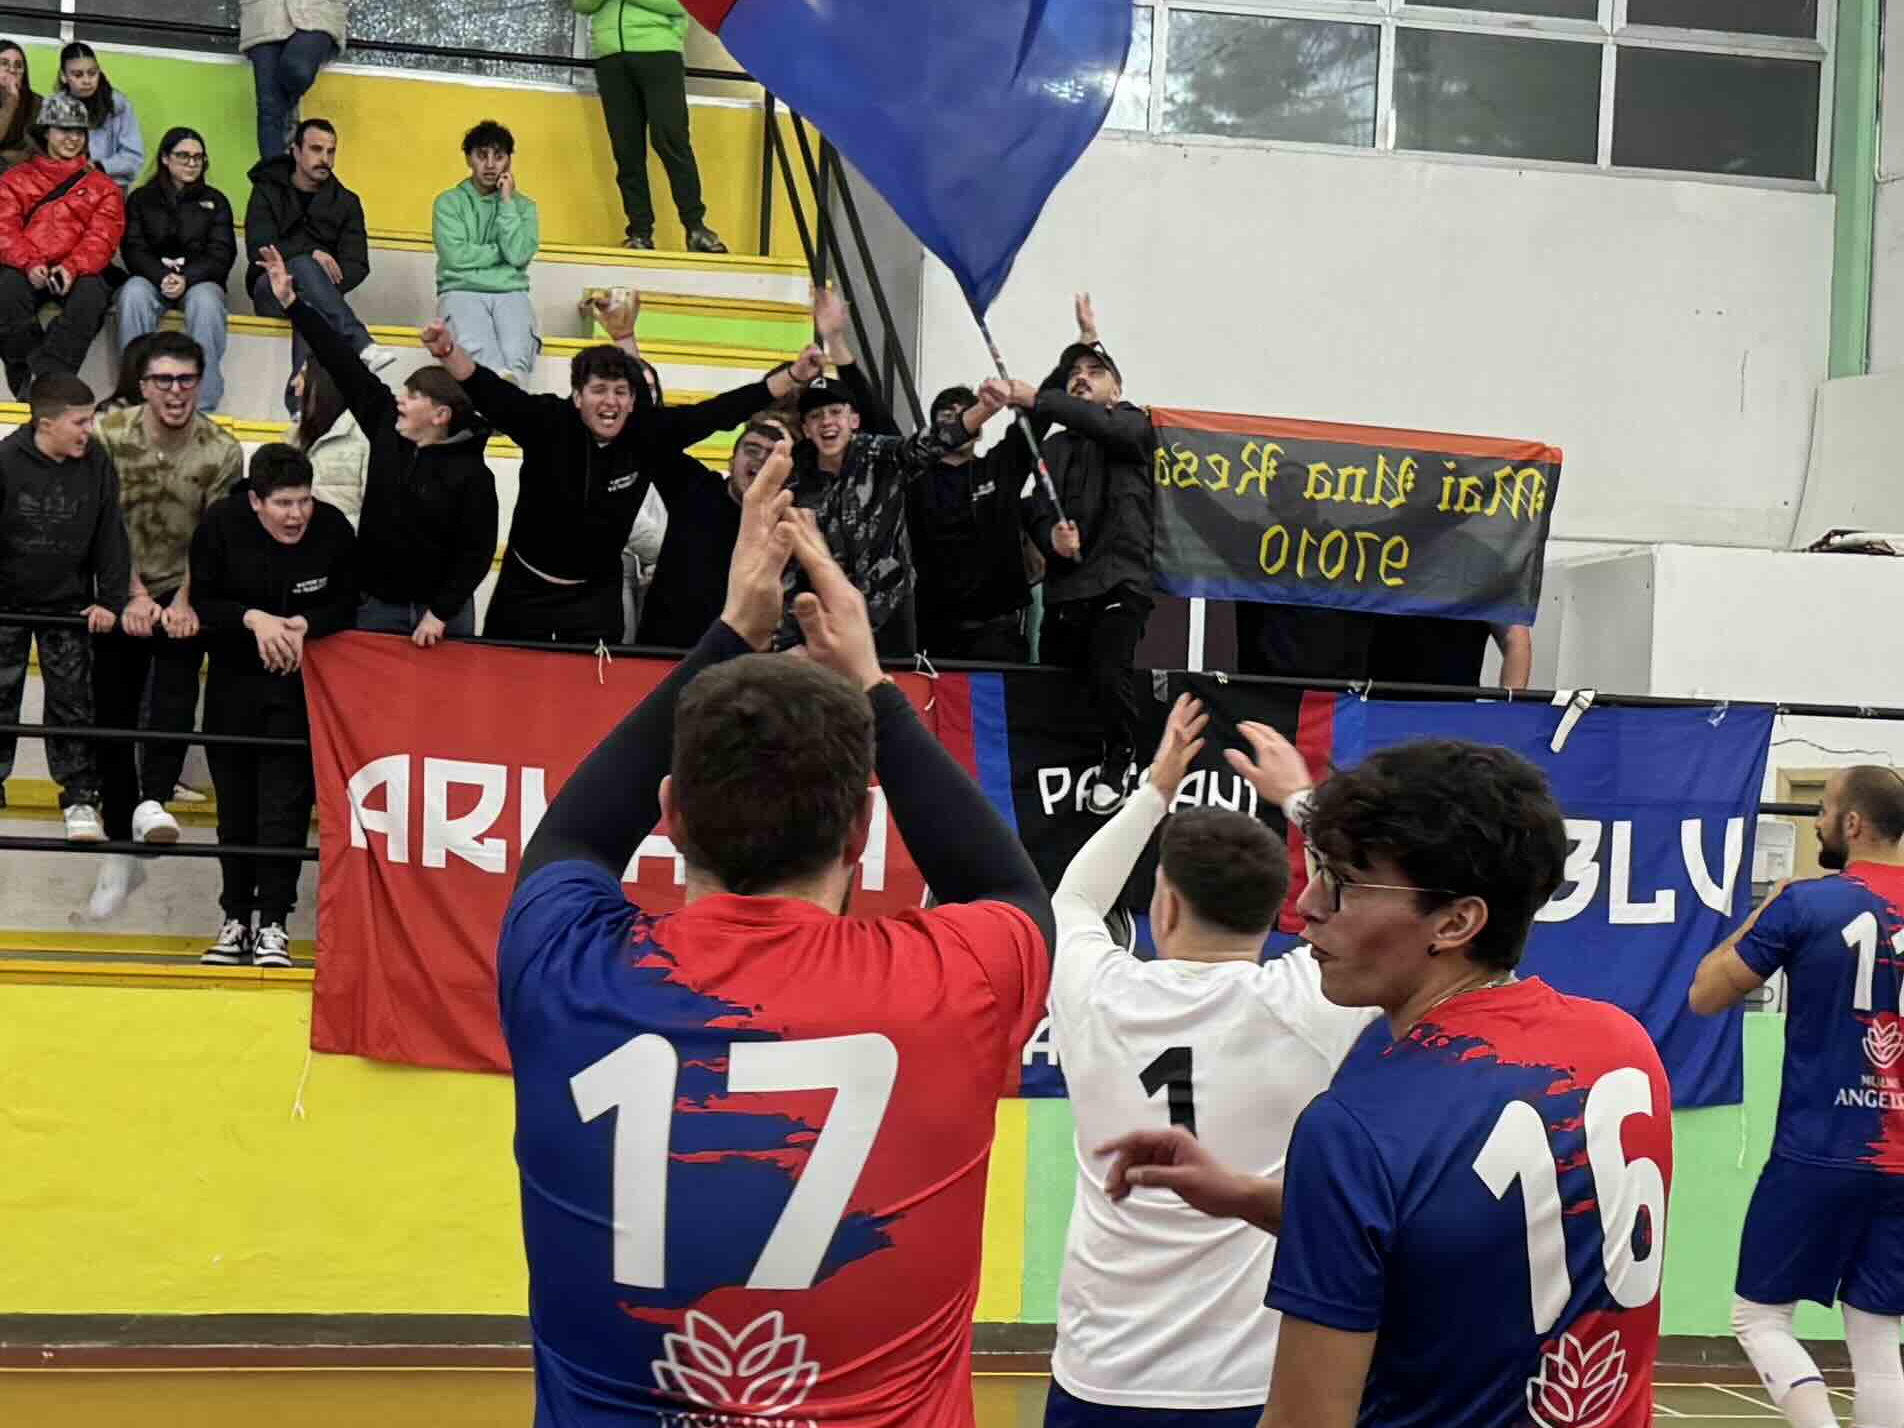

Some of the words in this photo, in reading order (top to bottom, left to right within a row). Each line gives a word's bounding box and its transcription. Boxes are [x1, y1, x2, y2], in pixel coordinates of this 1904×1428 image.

[569, 1032, 899, 1290] 17
[1138, 1046, 1197, 1138] 1
[1471, 1066, 1666, 1335] 16
